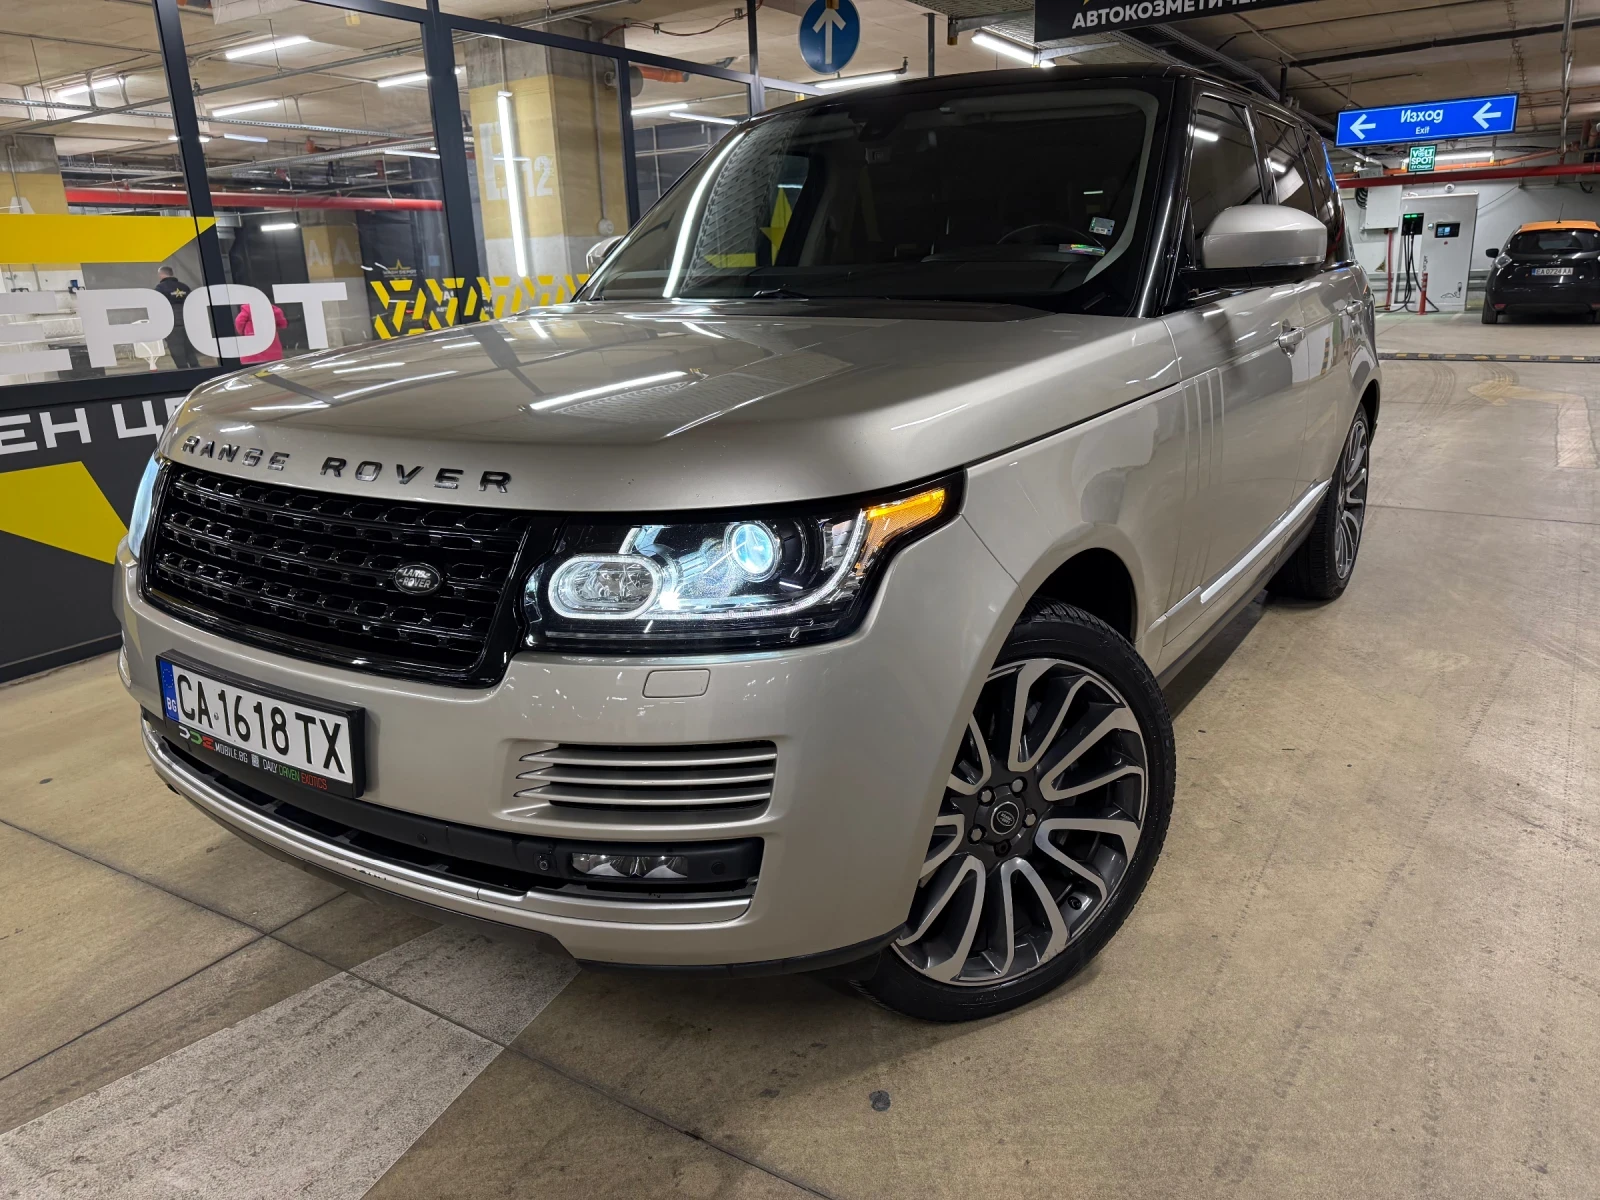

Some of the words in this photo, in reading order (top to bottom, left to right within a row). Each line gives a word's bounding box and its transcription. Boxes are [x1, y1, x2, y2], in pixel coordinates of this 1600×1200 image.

[1072, 0, 1262, 29] АВТОКОЗМЕТИ
[1401, 109, 1443, 123] Изход
[1415, 126, 1430, 134] Exit
[1412, 148, 1434, 158] VOLT
[1411, 156, 1433, 165] SPOT
[181, 435, 290, 471] RANGE
[320, 456, 512, 493] ROVER
[167, 697, 177, 712] BG
[301, 772, 328, 790] EXOTICS
